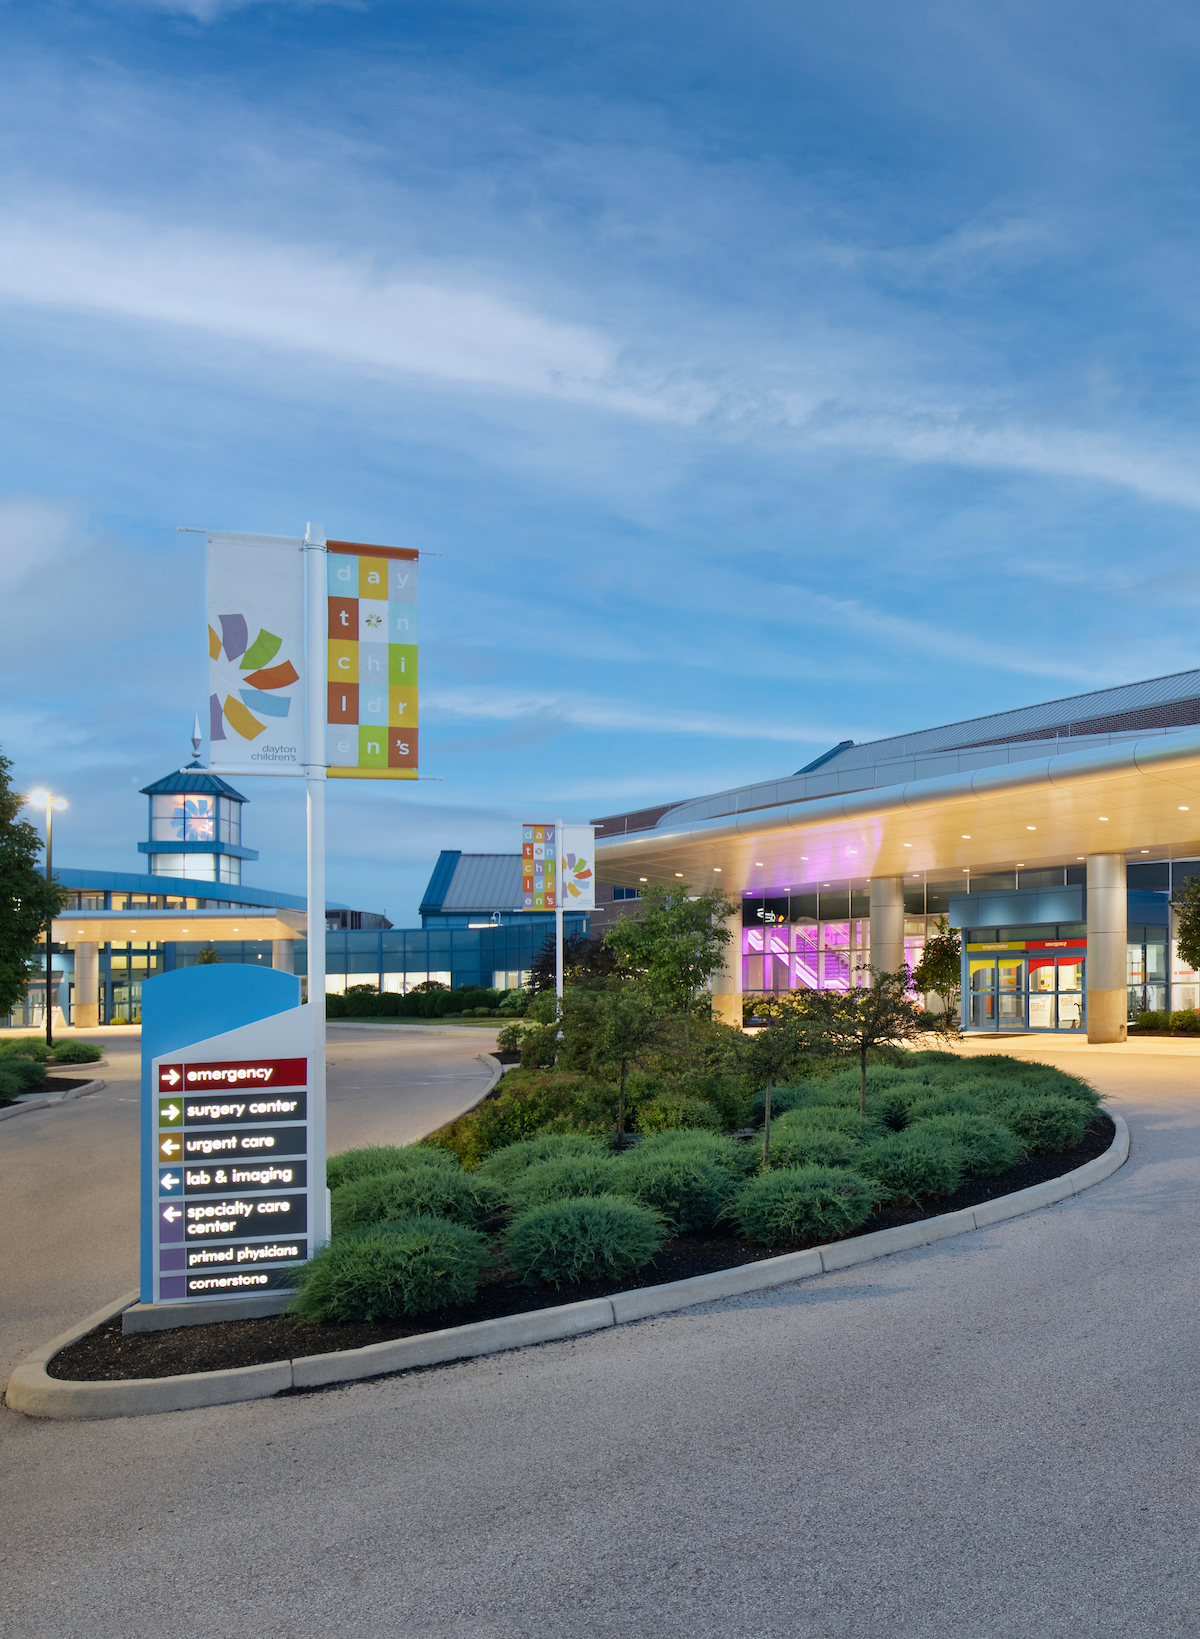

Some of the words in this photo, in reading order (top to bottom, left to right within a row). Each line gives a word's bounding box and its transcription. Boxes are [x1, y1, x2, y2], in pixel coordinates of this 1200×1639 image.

[250, 752, 297, 761] children's
[262, 744, 297, 754] dayton
[186, 1066, 273, 1083] emergency
[186, 1102, 245, 1118] surgery
[249, 1100, 297, 1114] center
[186, 1136, 237, 1153] urgent
[241, 1135, 275, 1148] care
[186, 1170, 211, 1186] lab
[214, 1169, 228, 1184] &
[232, 1167, 293, 1183] imaging
[187, 1201, 253, 1219] specialty
[257, 1201, 291, 1213] care
[187, 1219, 236, 1235] center
[189, 1248, 234, 1266] primed
[237, 1244, 298, 1262] physicians
[189, 1273, 268, 1290] cornerstone
